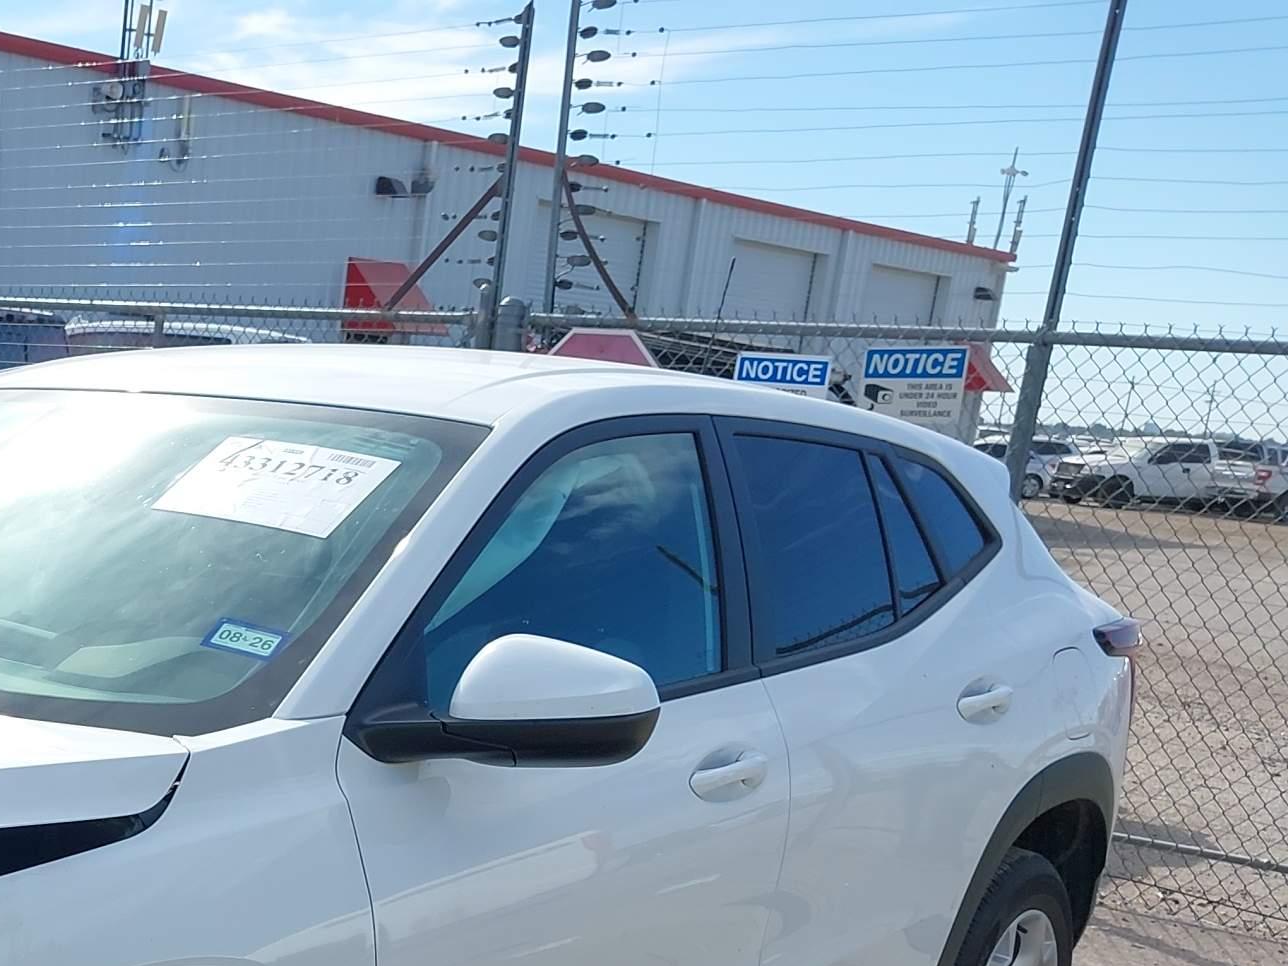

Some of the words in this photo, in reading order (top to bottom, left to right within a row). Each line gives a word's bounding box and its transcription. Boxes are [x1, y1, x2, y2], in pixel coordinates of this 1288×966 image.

[741, 359, 824, 383] NOTICE
[867, 352, 963, 375] NOTICE
[907, 383, 923, 391] THIS
[924, 383, 943, 391] AREA
[899, 409, 952, 417] SURVEILLANCE
[218, 453, 360, 486] 43312718
